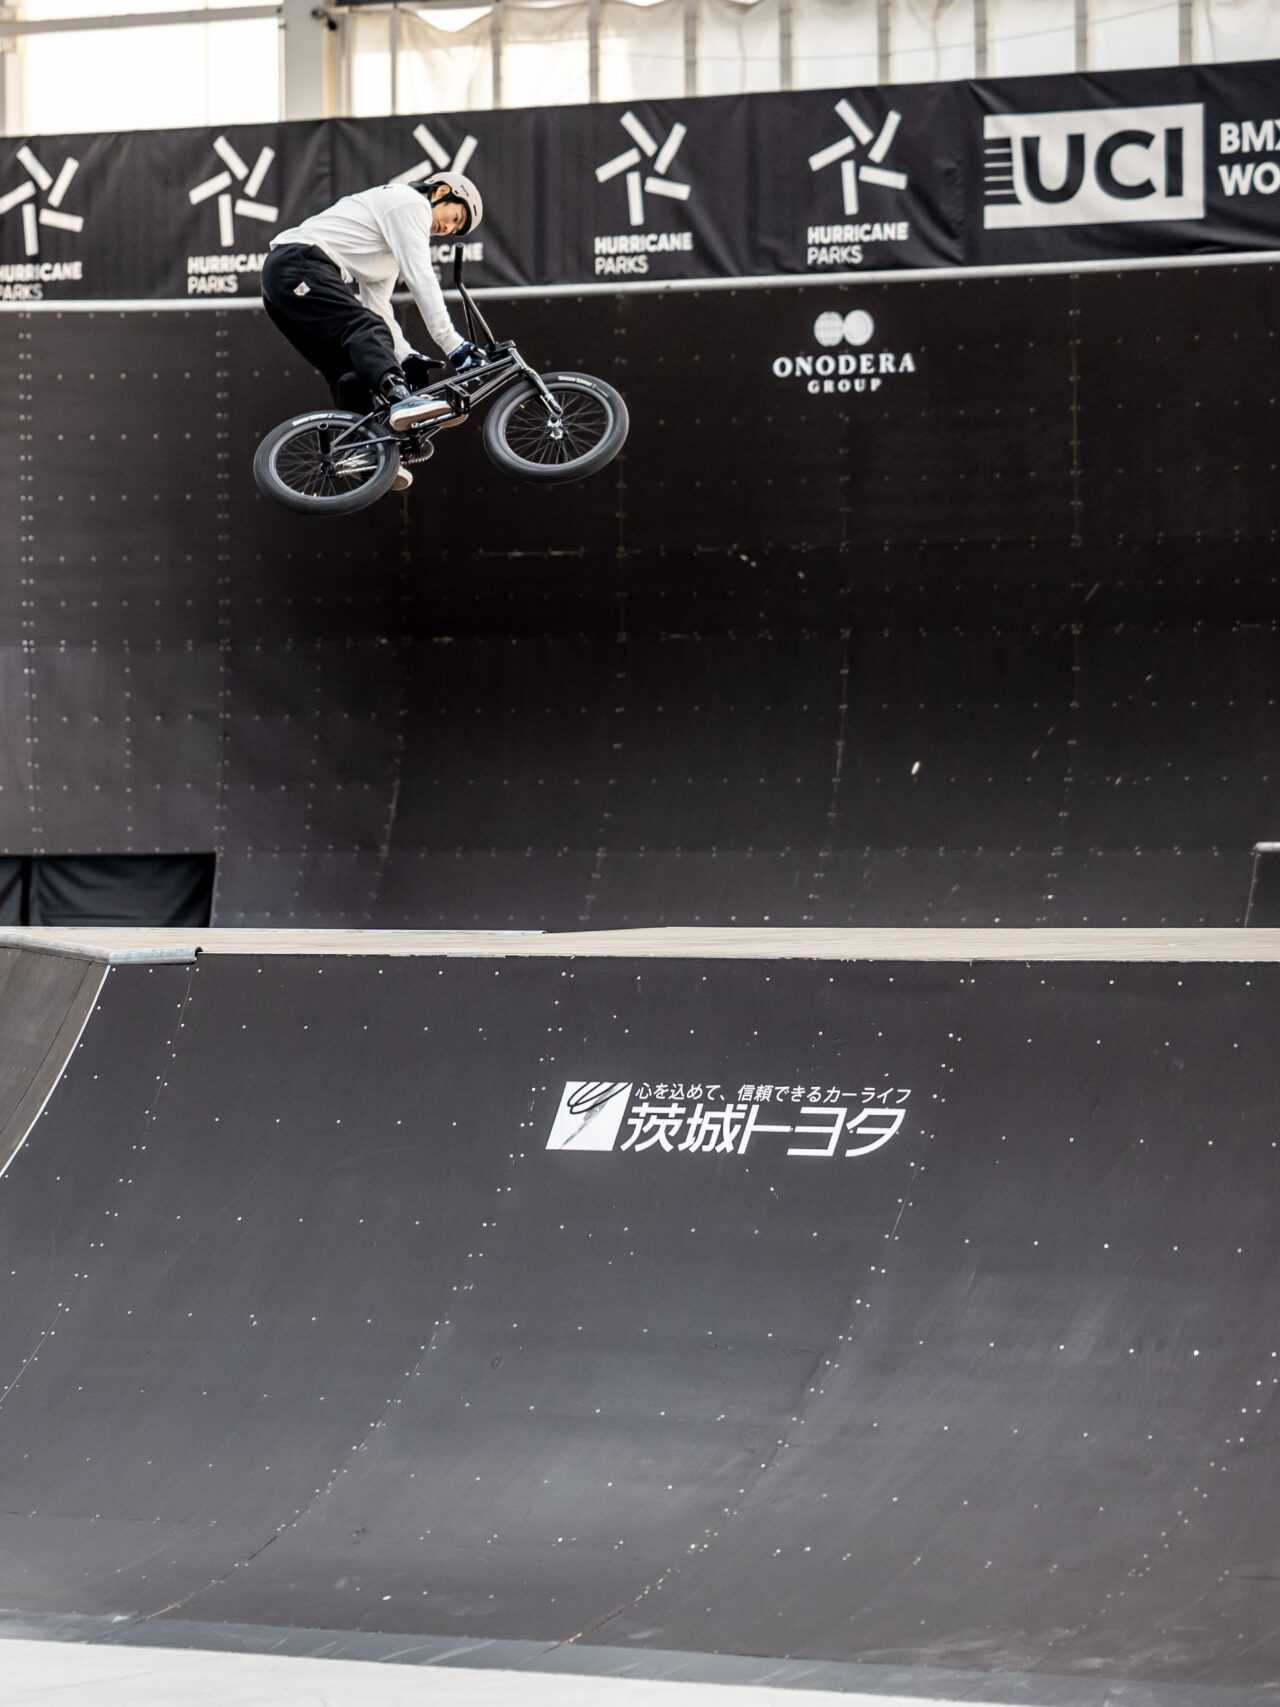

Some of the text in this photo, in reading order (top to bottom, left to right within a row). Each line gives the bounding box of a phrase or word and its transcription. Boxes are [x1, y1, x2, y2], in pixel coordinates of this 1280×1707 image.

[1021, 127, 1183, 204] UCI
[594, 231, 694, 255] HURRICANE
[807, 221, 910, 245] HURRICANE
[187, 252, 269, 275] HURRICAN
[594, 254, 650, 275] PARKS
[807, 245, 863, 266] PARKS
[187, 274, 239, 295] PARKS
[772, 352, 916, 378] ONODERA
[807, 377, 883, 394] GROUP
[635, 1083, 912, 1105] 心を込めて、信頼できるカーライフ
[620, 1102, 907, 1158] 茨城トヨタ
